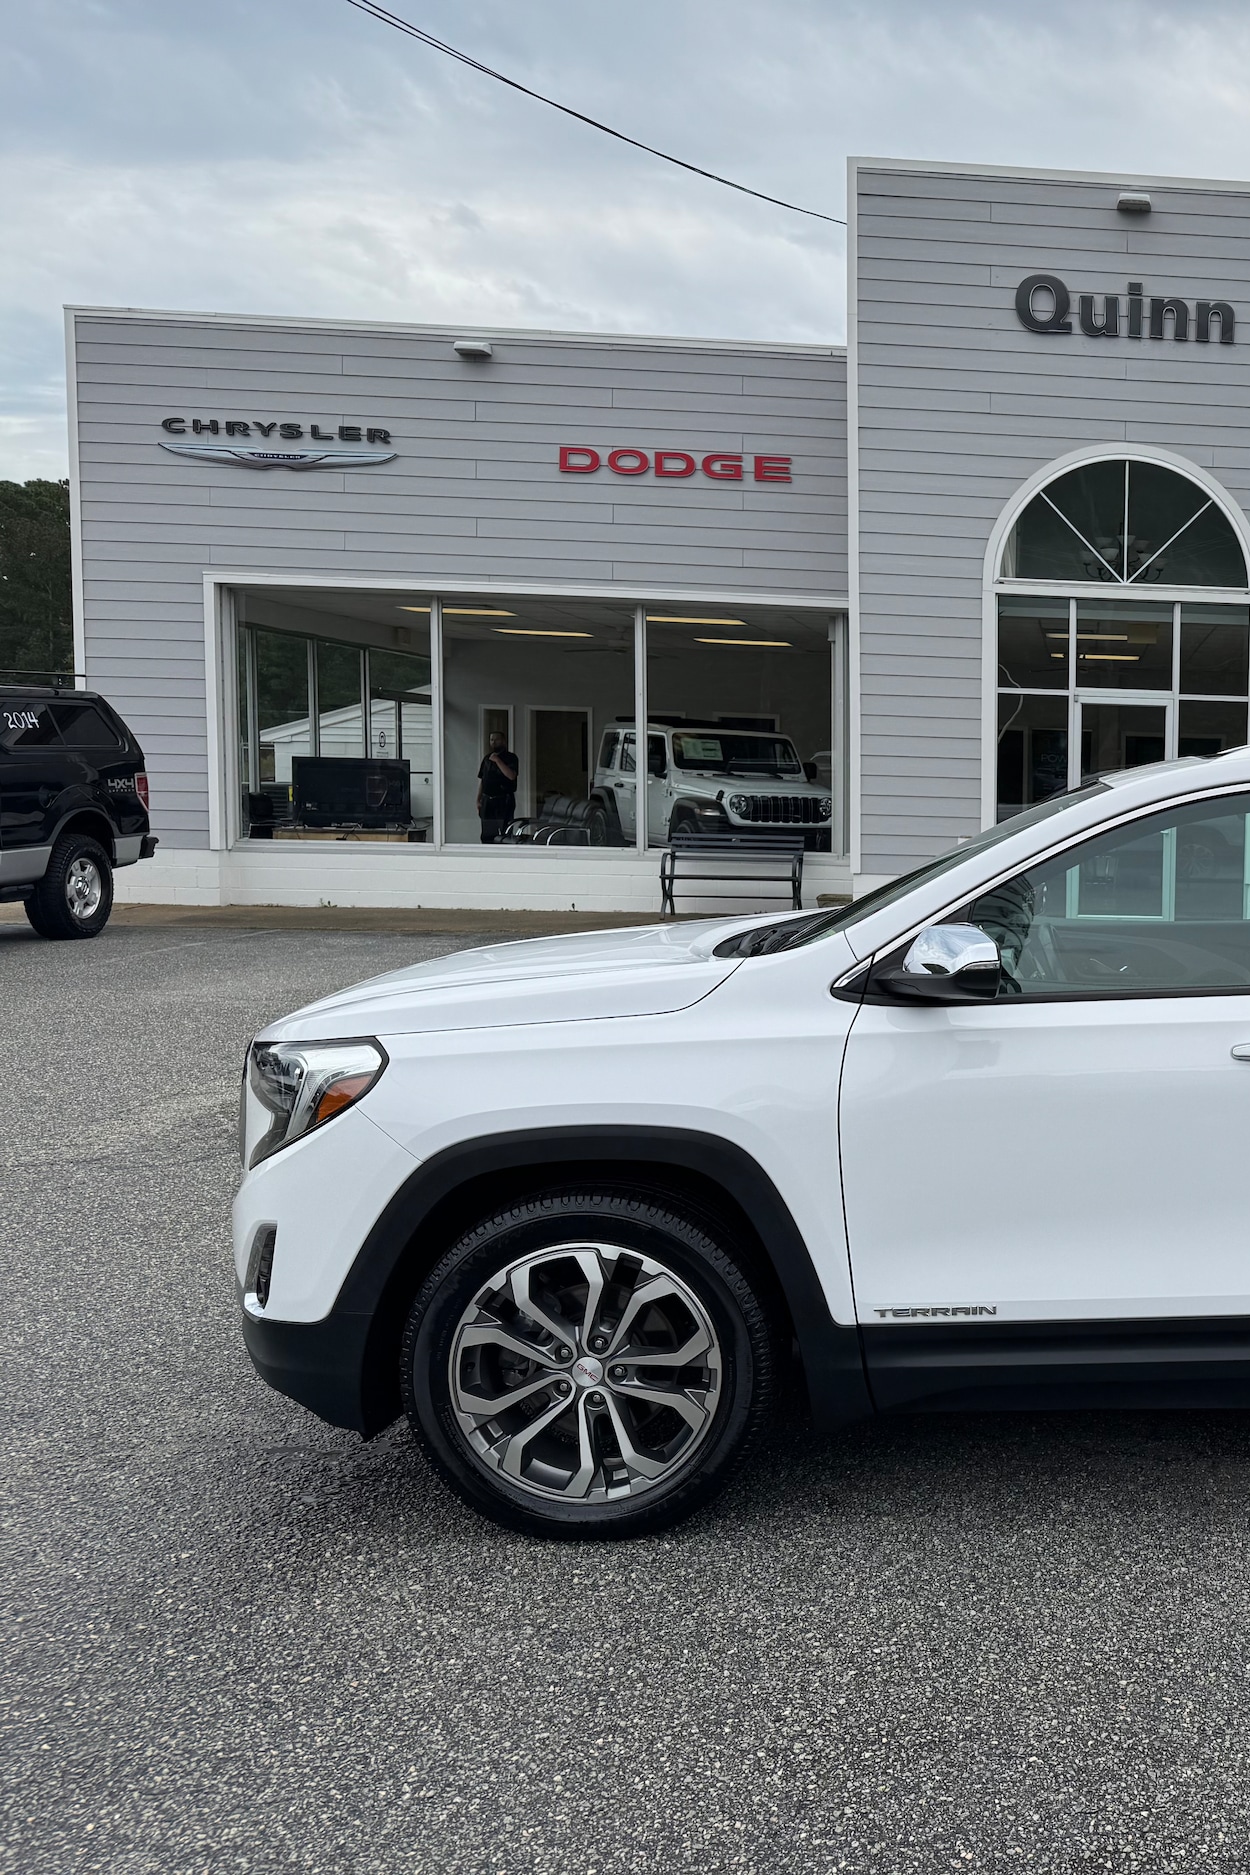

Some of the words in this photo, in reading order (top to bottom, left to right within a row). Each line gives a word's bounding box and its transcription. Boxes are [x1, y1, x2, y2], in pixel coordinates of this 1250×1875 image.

[1015, 273, 1235, 343] Quinn
[161, 417, 392, 444] CHRYSLER
[559, 446, 793, 483] DODGE
[3, 711, 40, 729] 2014
[873, 1304, 998, 1318] TERRAIN
[576, 1363, 600, 1382] GMC
